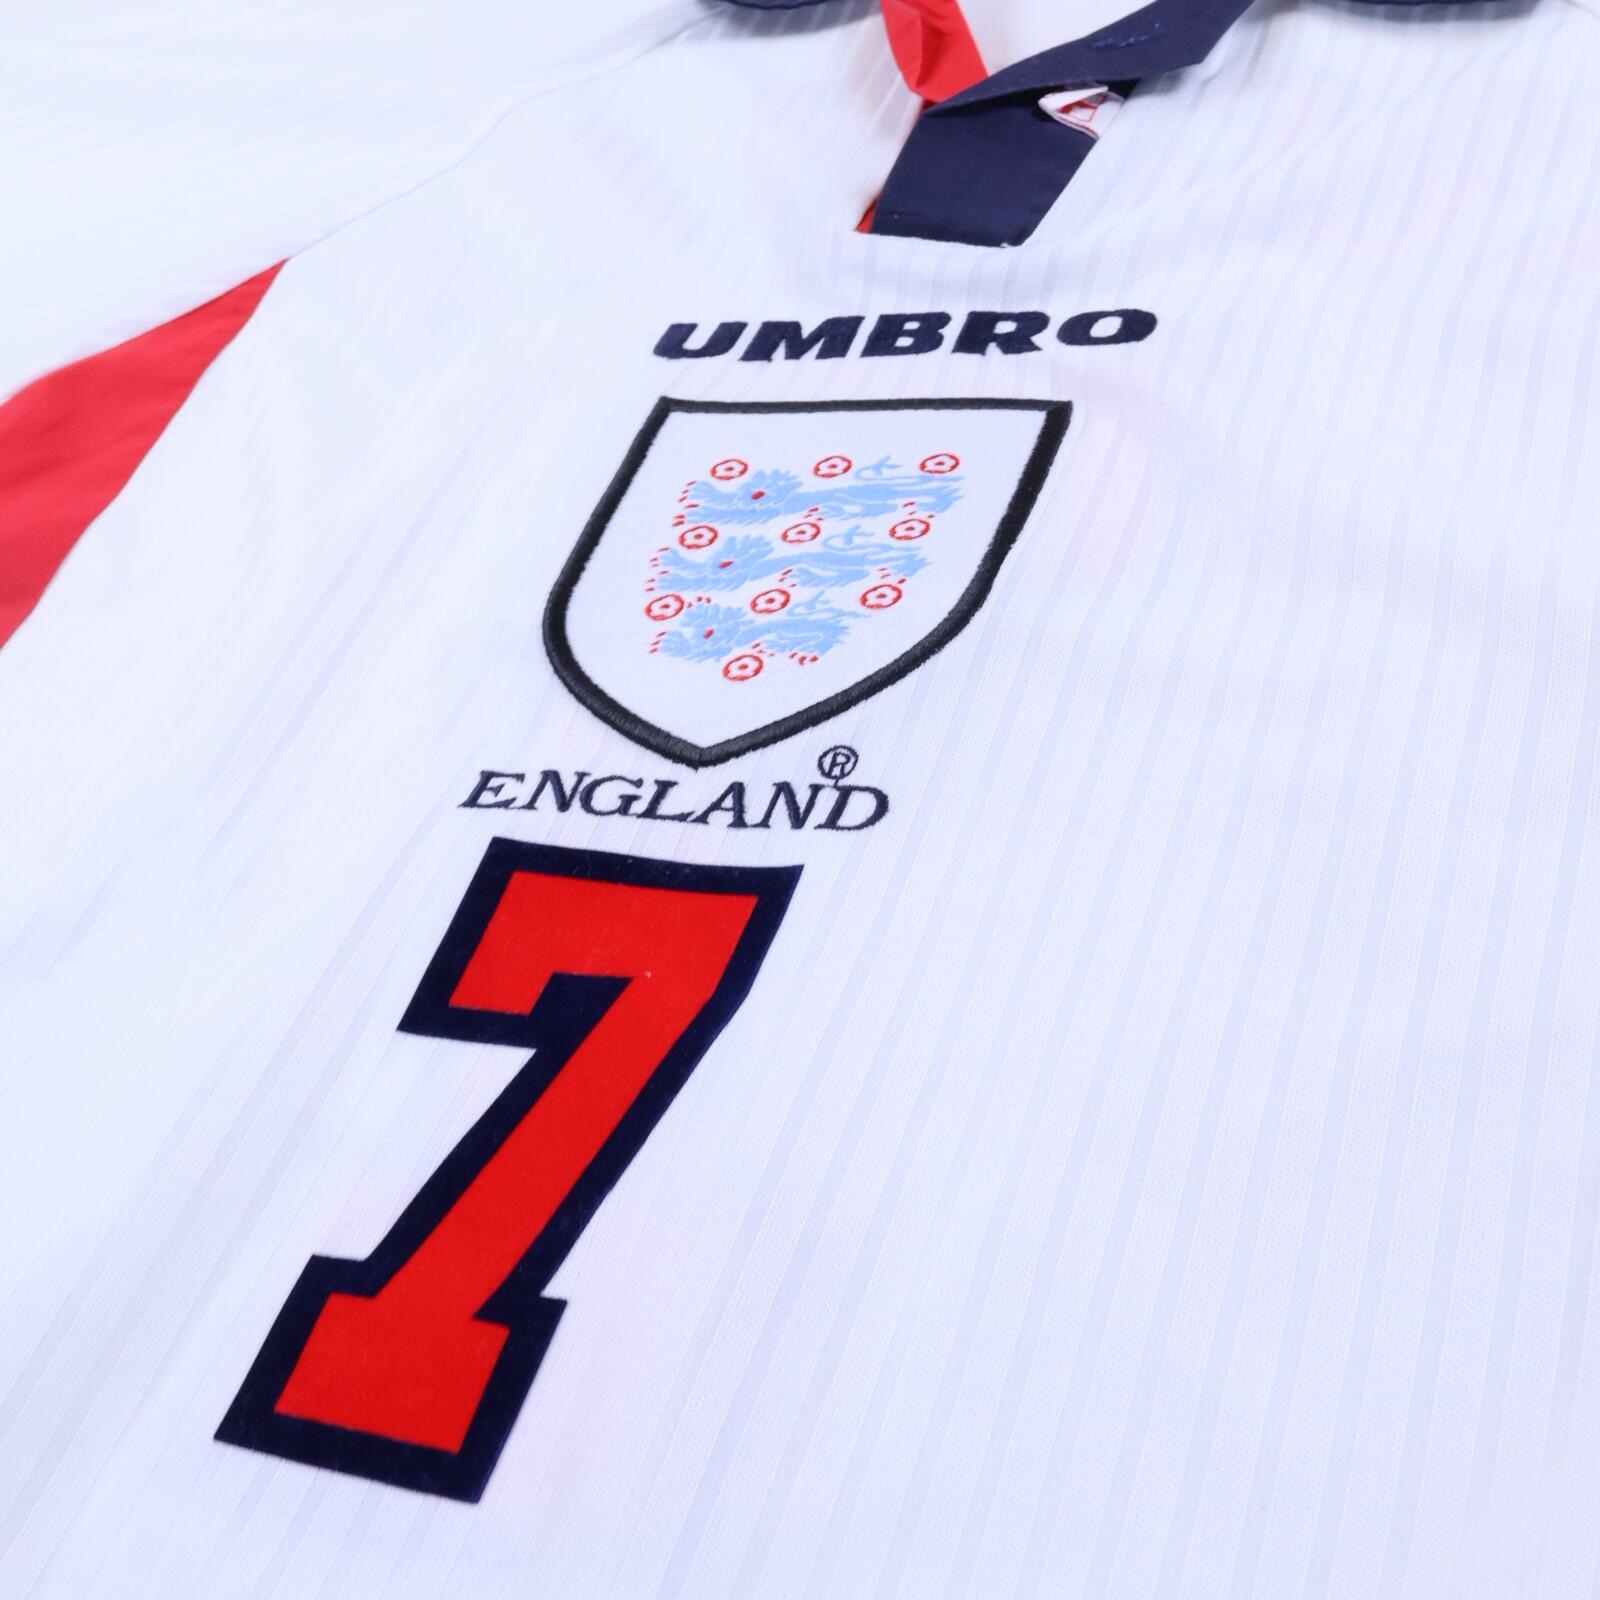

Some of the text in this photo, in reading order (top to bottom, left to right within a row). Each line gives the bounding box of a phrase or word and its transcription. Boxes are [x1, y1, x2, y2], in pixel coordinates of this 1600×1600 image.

[653, 309, 1157, 362] UMBRO
[458, 769, 890, 831] ENGLAND
[213, 837, 804, 1504] 7
